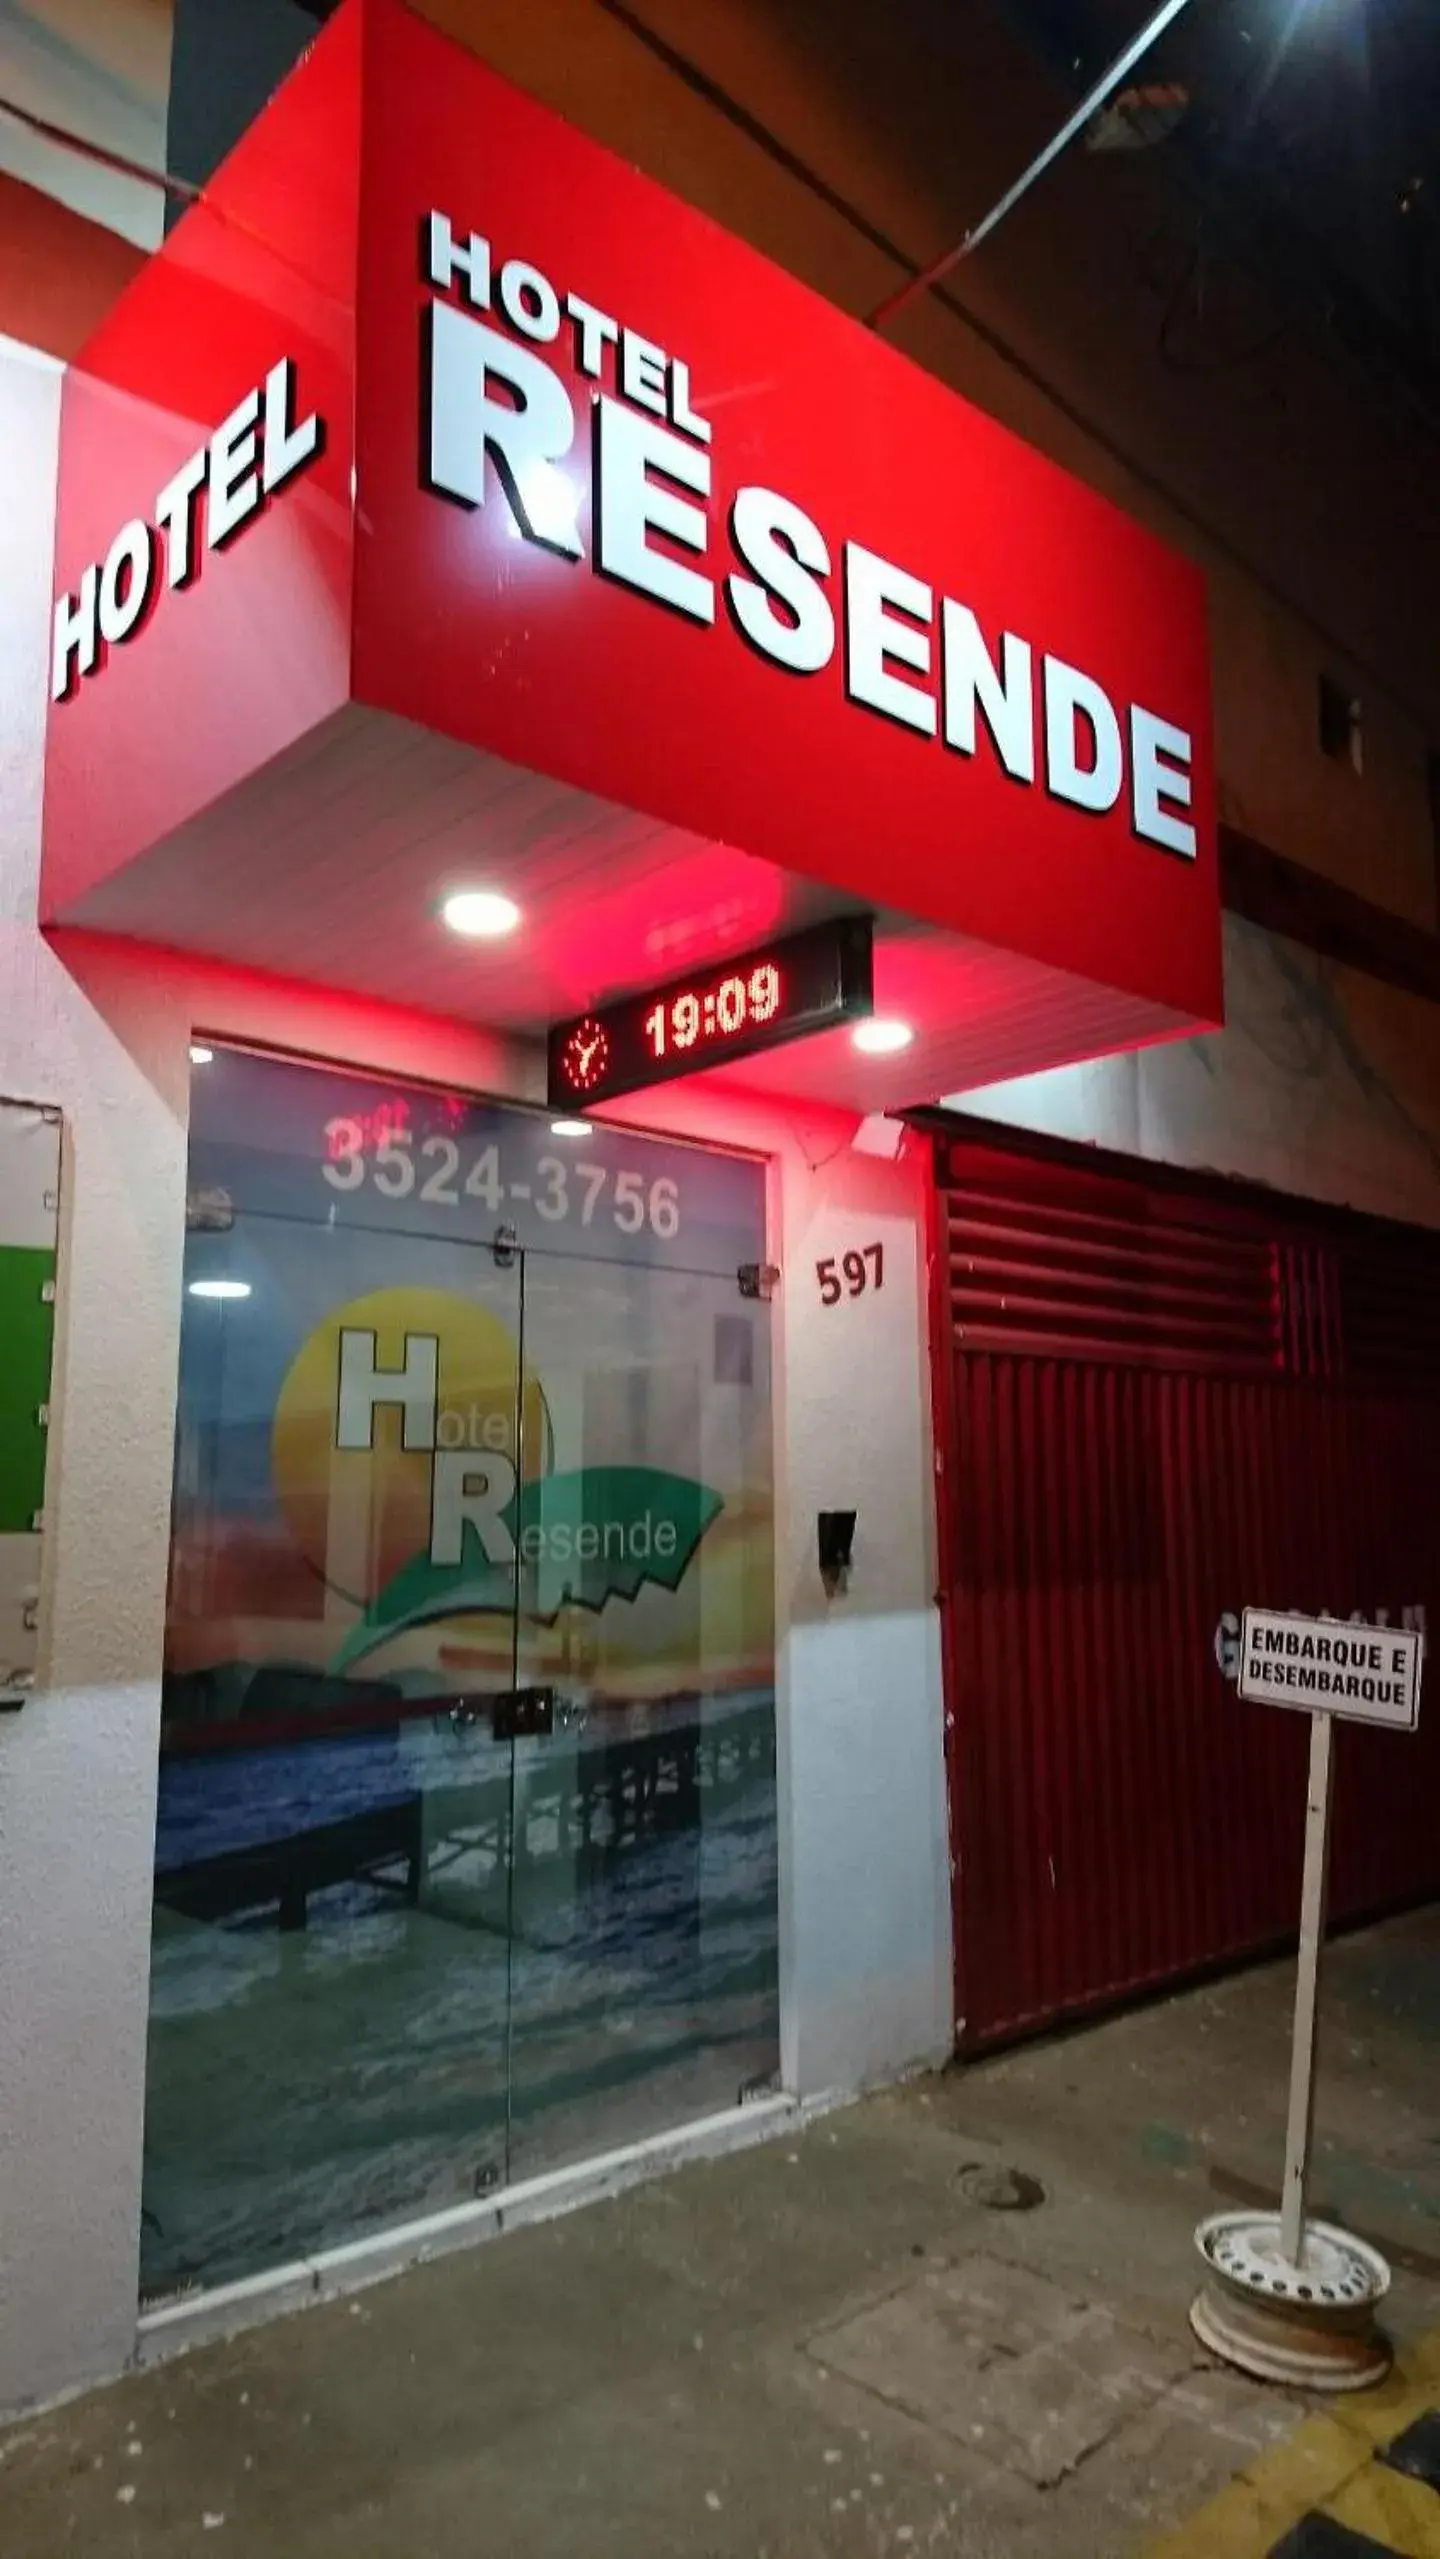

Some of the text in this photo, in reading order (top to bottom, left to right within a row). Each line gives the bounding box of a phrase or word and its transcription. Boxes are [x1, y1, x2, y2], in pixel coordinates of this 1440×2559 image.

[428, 209, 711, 444] HOTEL
[52, 355, 322, 703] HOTEL
[428, 297, 1198, 860] RESENDE
[645, 963, 780, 1056] 19:09
[321, 1116, 680, 1238] 3524-3756
[815, 1241, 883, 1306] 597
[430, 1446, 678, 1567] Resende
[1249, 1659, 1406, 1706] DESEMBARQUE
[1252, 1627, 1382, 1671] EMBARQUE
[1391, 1649, 1406, 1674] E
